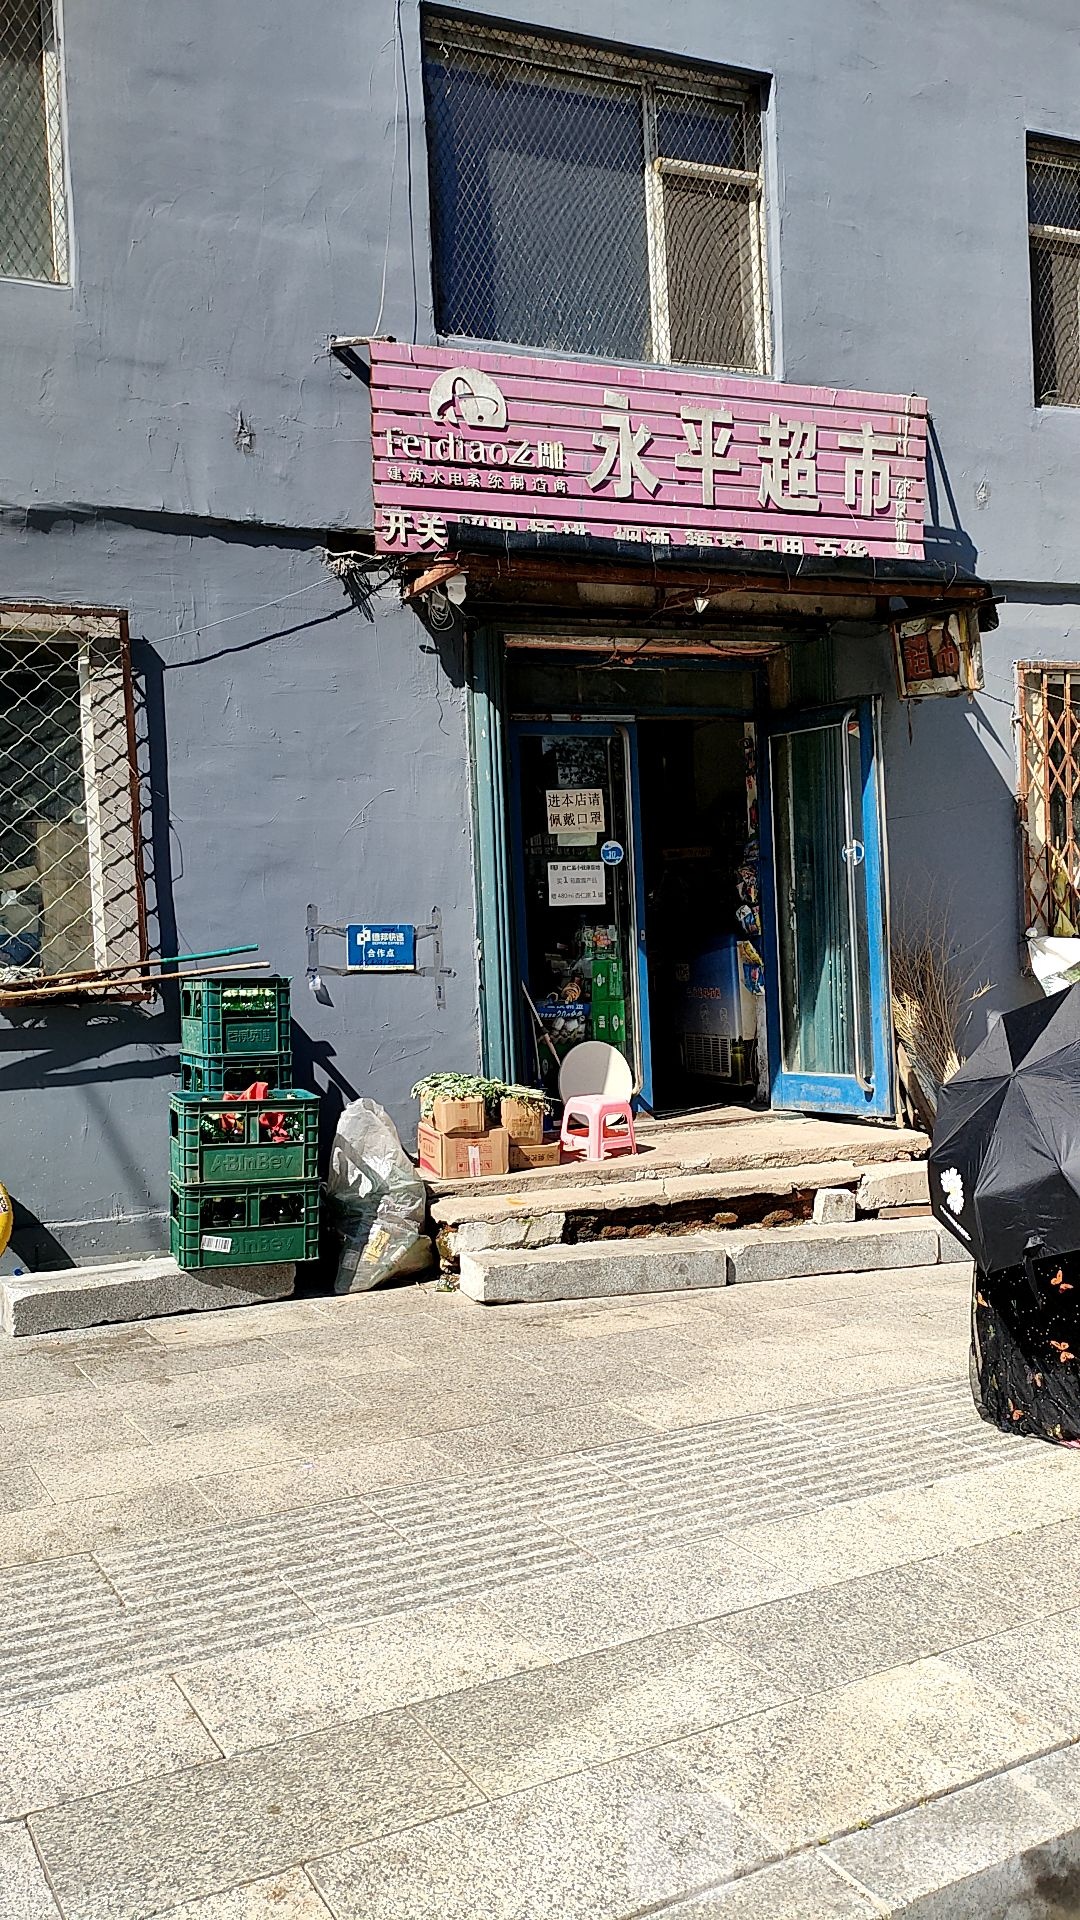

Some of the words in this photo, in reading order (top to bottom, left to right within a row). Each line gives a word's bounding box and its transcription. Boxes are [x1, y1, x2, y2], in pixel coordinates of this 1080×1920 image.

[384, 427, 509, 465] Feidiao
[585, 389, 899, 517] 永平超市
[387, 466, 568, 494] 建筑水电系统制造商
[382, 510, 447, 547] 开关
[547, 792, 602, 808] 进本店请
[549, 811, 602, 828] 佩戴口罩
[366, 948, 395, 958] 合作点
[211, 1152, 293, 1173] ABInBev
